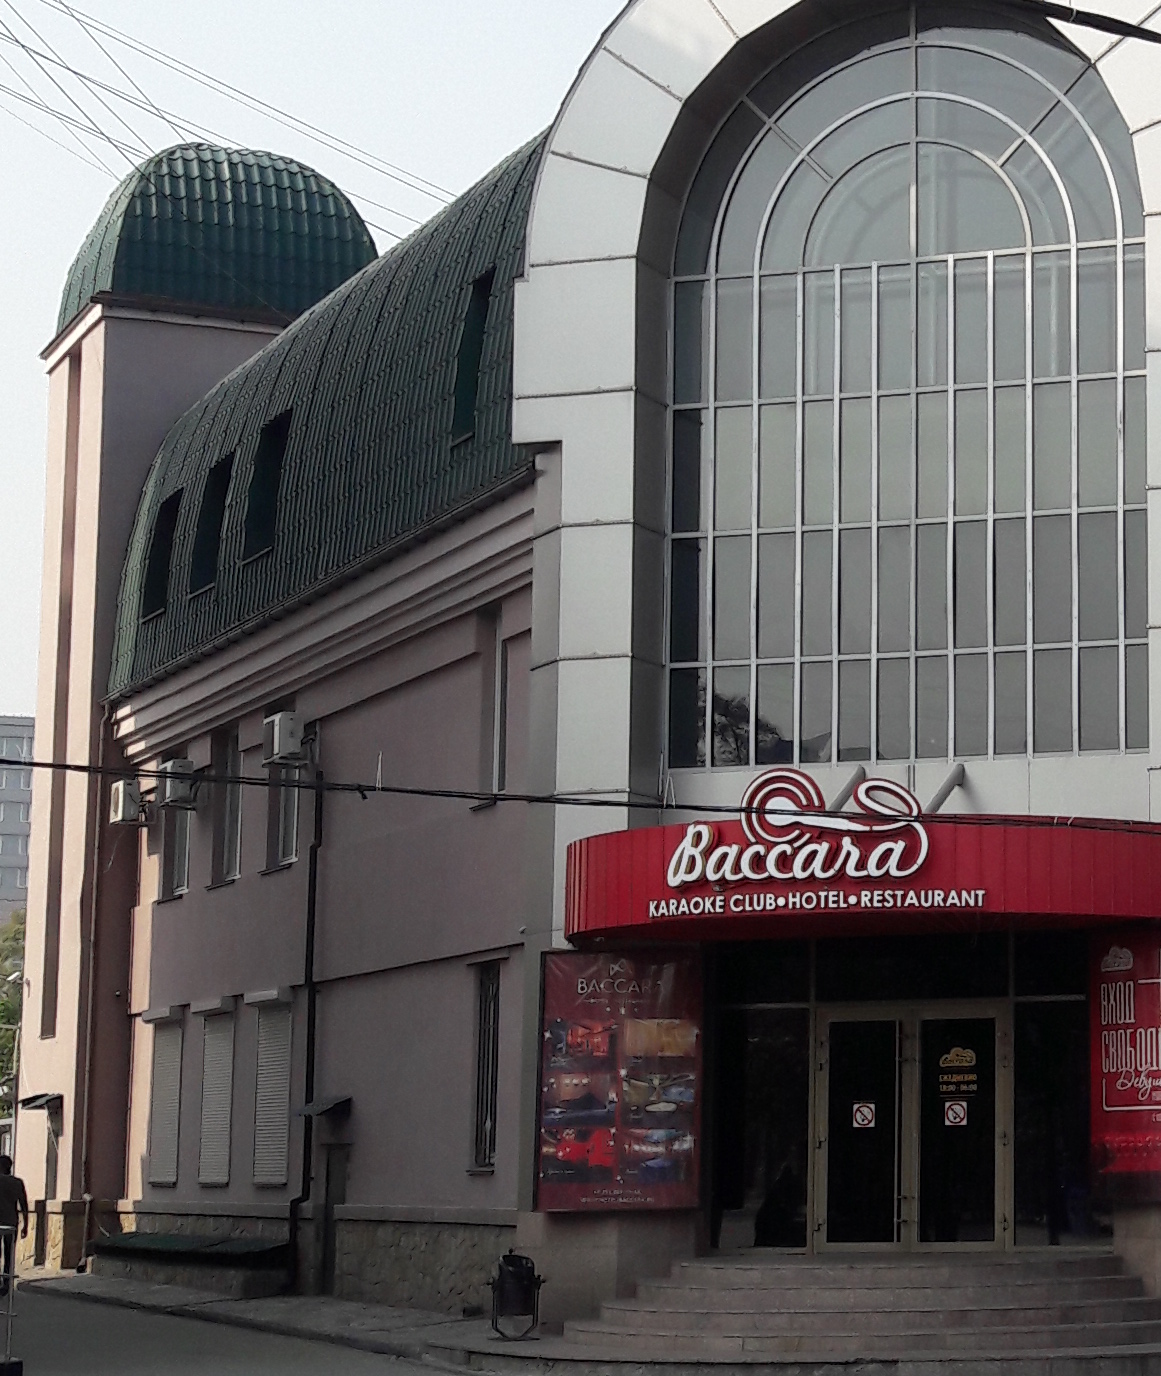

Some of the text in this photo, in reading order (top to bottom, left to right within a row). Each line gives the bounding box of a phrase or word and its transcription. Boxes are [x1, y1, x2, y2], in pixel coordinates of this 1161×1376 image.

[666, 821, 930, 888] Baccara
[648, 888, 986, 918] KARAOKE CLUB HOTEL RESTAURANT
[577, 978, 666, 994] BACCAR
[1100, 980, 1136, 1026] ВХОД
